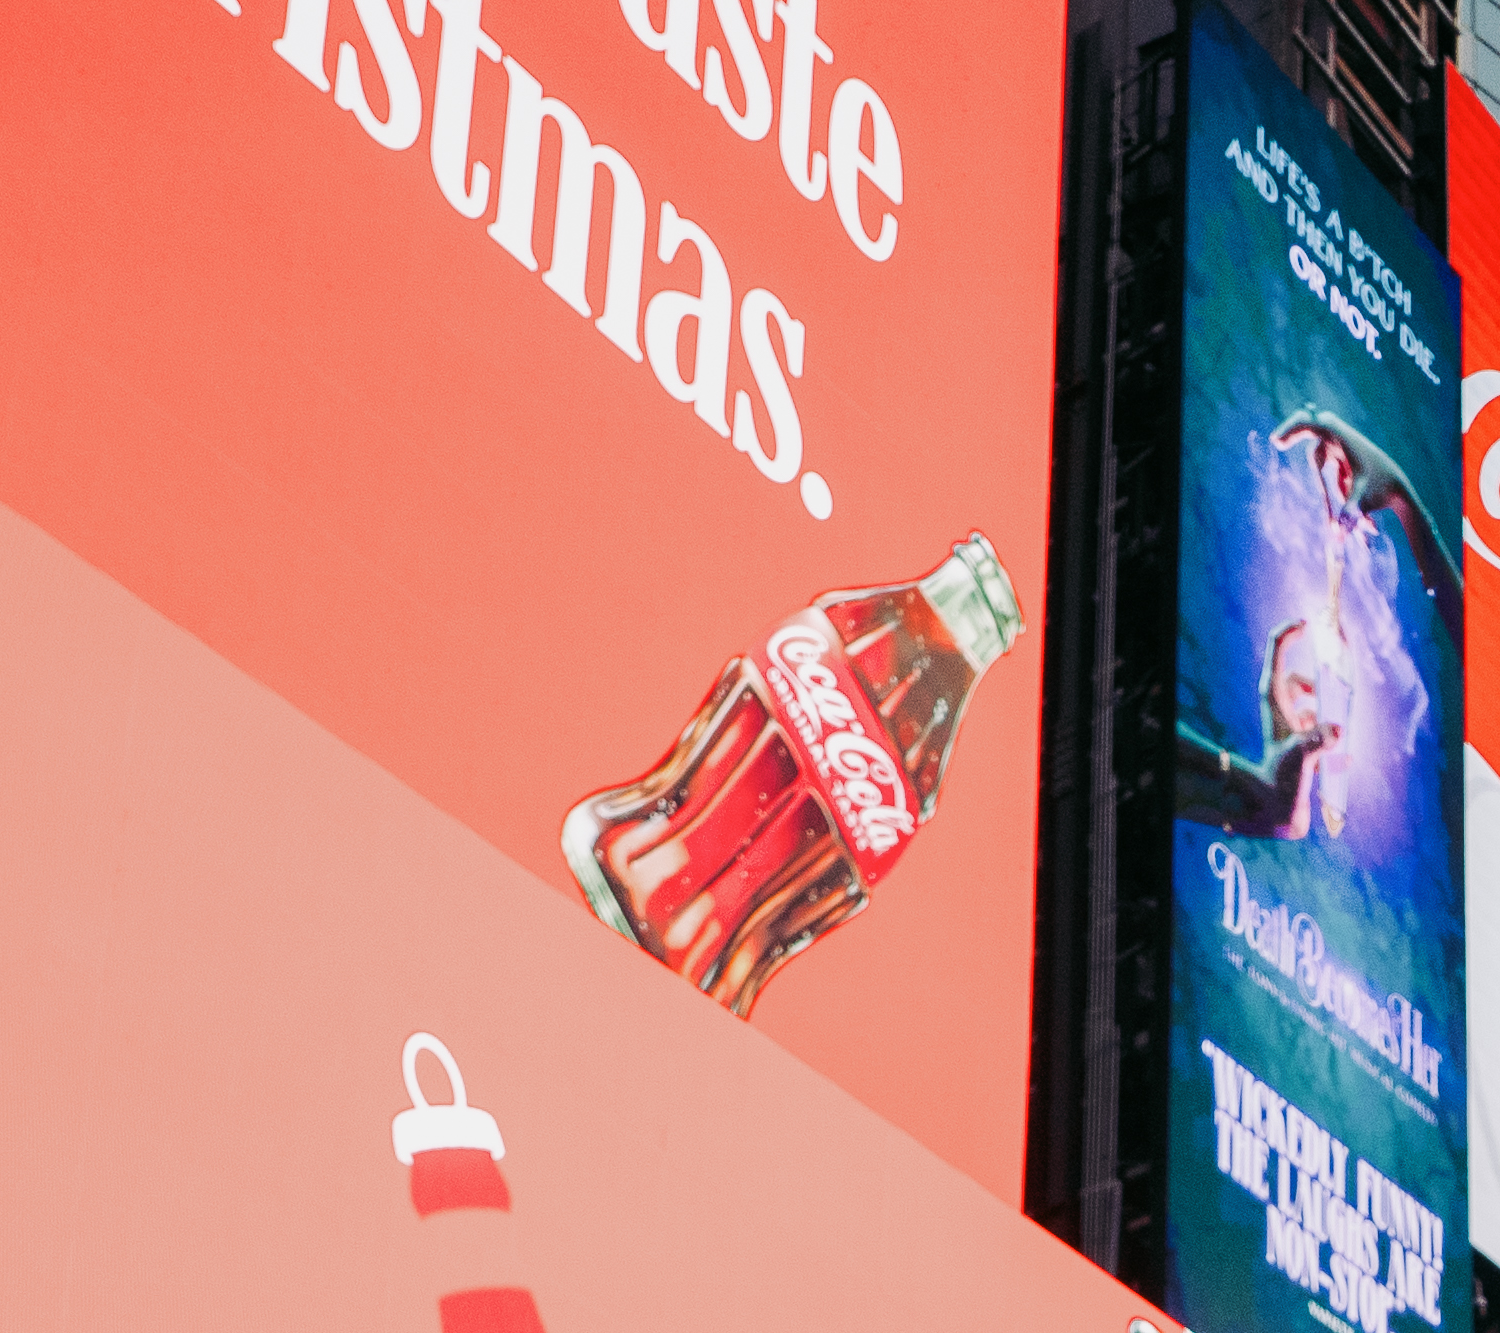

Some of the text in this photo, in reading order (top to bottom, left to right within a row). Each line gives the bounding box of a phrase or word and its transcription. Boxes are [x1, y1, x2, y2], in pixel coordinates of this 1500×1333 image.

[1224, 138, 1441, 385] AND THEN YOU DIE.
[1257, 125, 1321, 212] LIFE'S
[1325, 209, 1344, 241] A
[1289, 244, 1383, 360] OR NOT.
[767, 625, 917, 856] Coca-Cola
[1207, 842, 1295, 978] Death
[1291, 912, 1400, 1064] Becomes
[1387, 992, 1442, 1100] Her
[1214, 1107, 1441, 1327] THE LAUGHS ARE
[1356, 1157, 1444, 1272] FUNNY!
